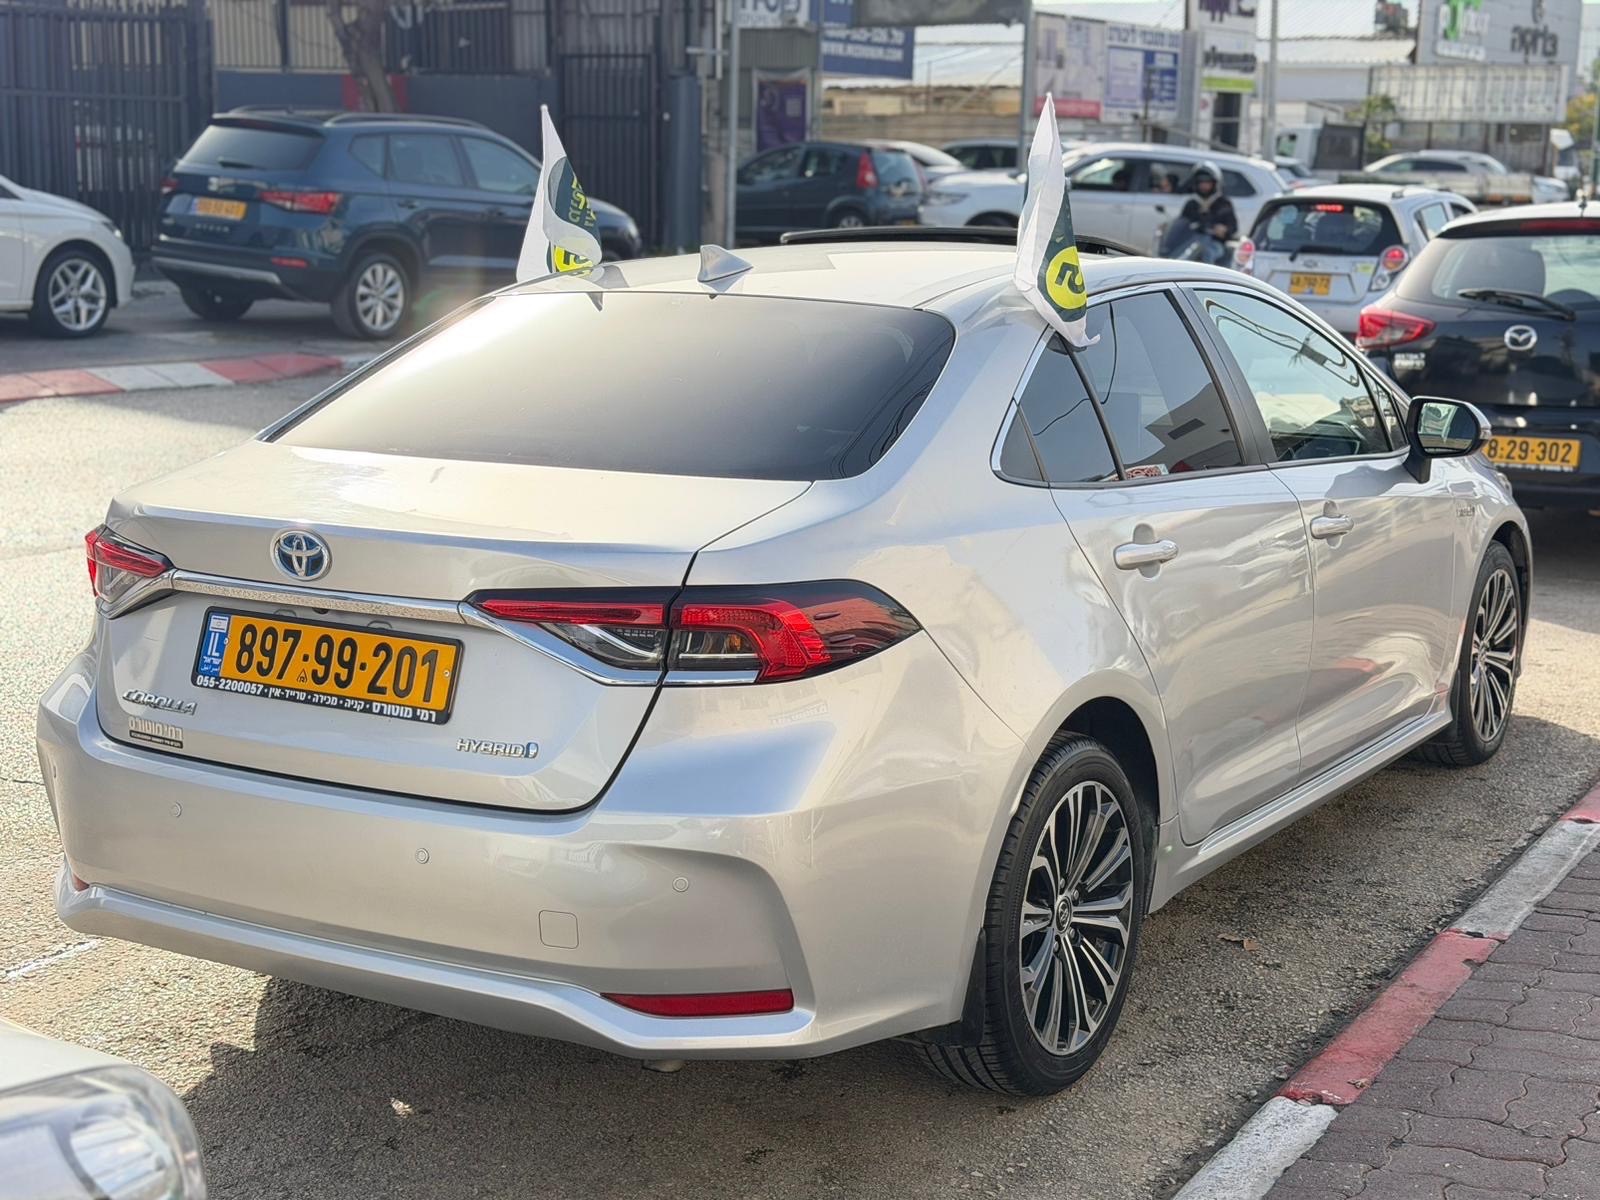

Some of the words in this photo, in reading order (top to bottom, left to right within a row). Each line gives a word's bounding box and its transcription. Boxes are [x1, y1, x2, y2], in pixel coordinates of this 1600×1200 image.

[207, 632, 220, 657] IL
[196, 675, 264, 696] 055-2200057
[312, 693, 338, 706] מכירה
[344, 698, 365, 712] קניה
[372, 702, 413, 718] מוטורס
[416, 710, 437, 722] רמי
[456, 737, 526, 759] HYBRID
